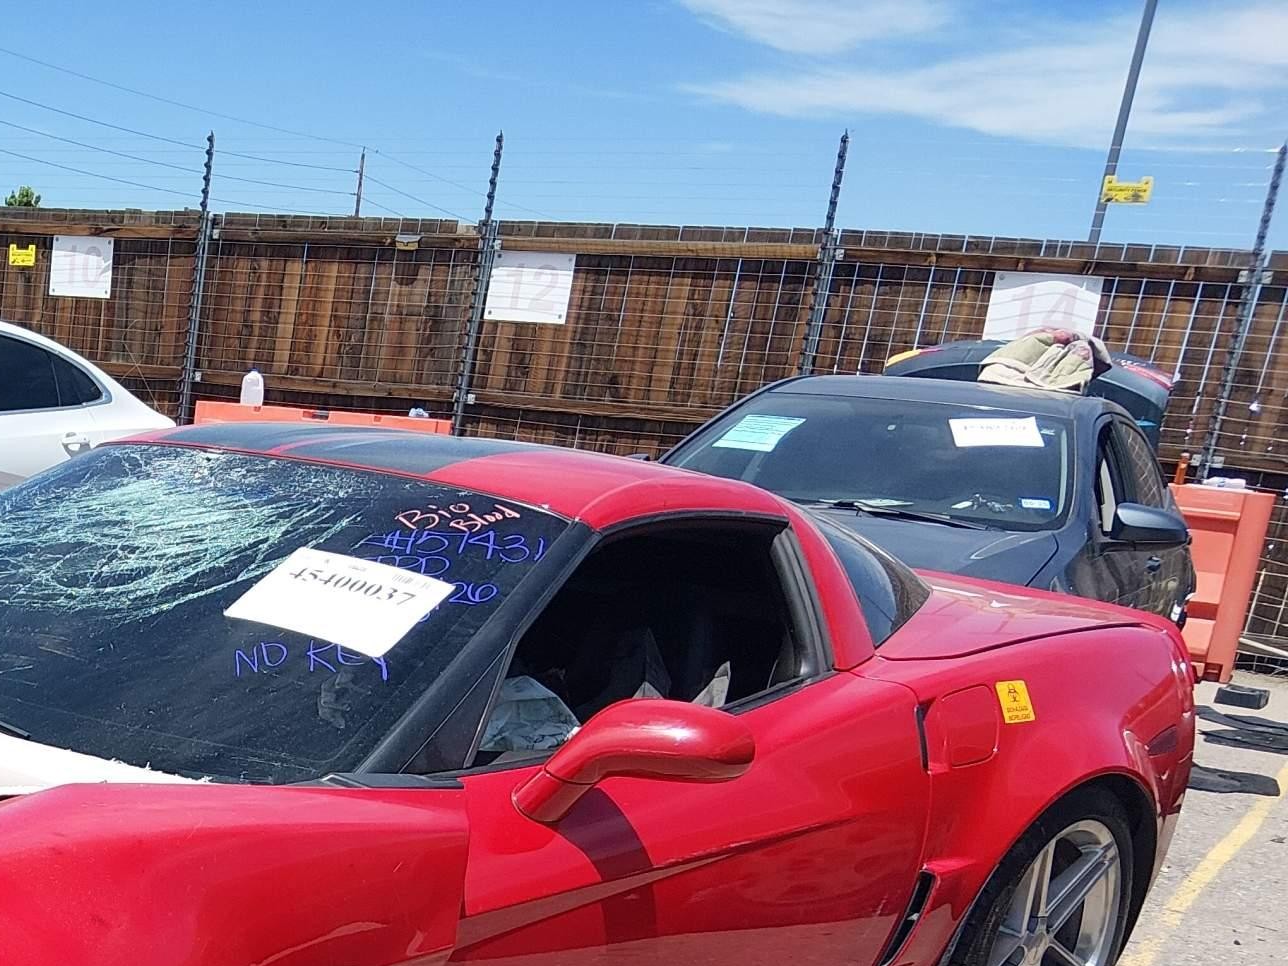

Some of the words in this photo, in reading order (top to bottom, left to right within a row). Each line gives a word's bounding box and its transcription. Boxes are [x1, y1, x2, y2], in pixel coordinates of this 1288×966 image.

[68, 245, 104, 288] 10
[507, 264, 560, 312] 12
[1015, 285, 1079, 338] 14
[395, 503, 470, 529] Bio
[449, 504, 521, 532] Blood
[289, 567, 417, 605] 45400037
